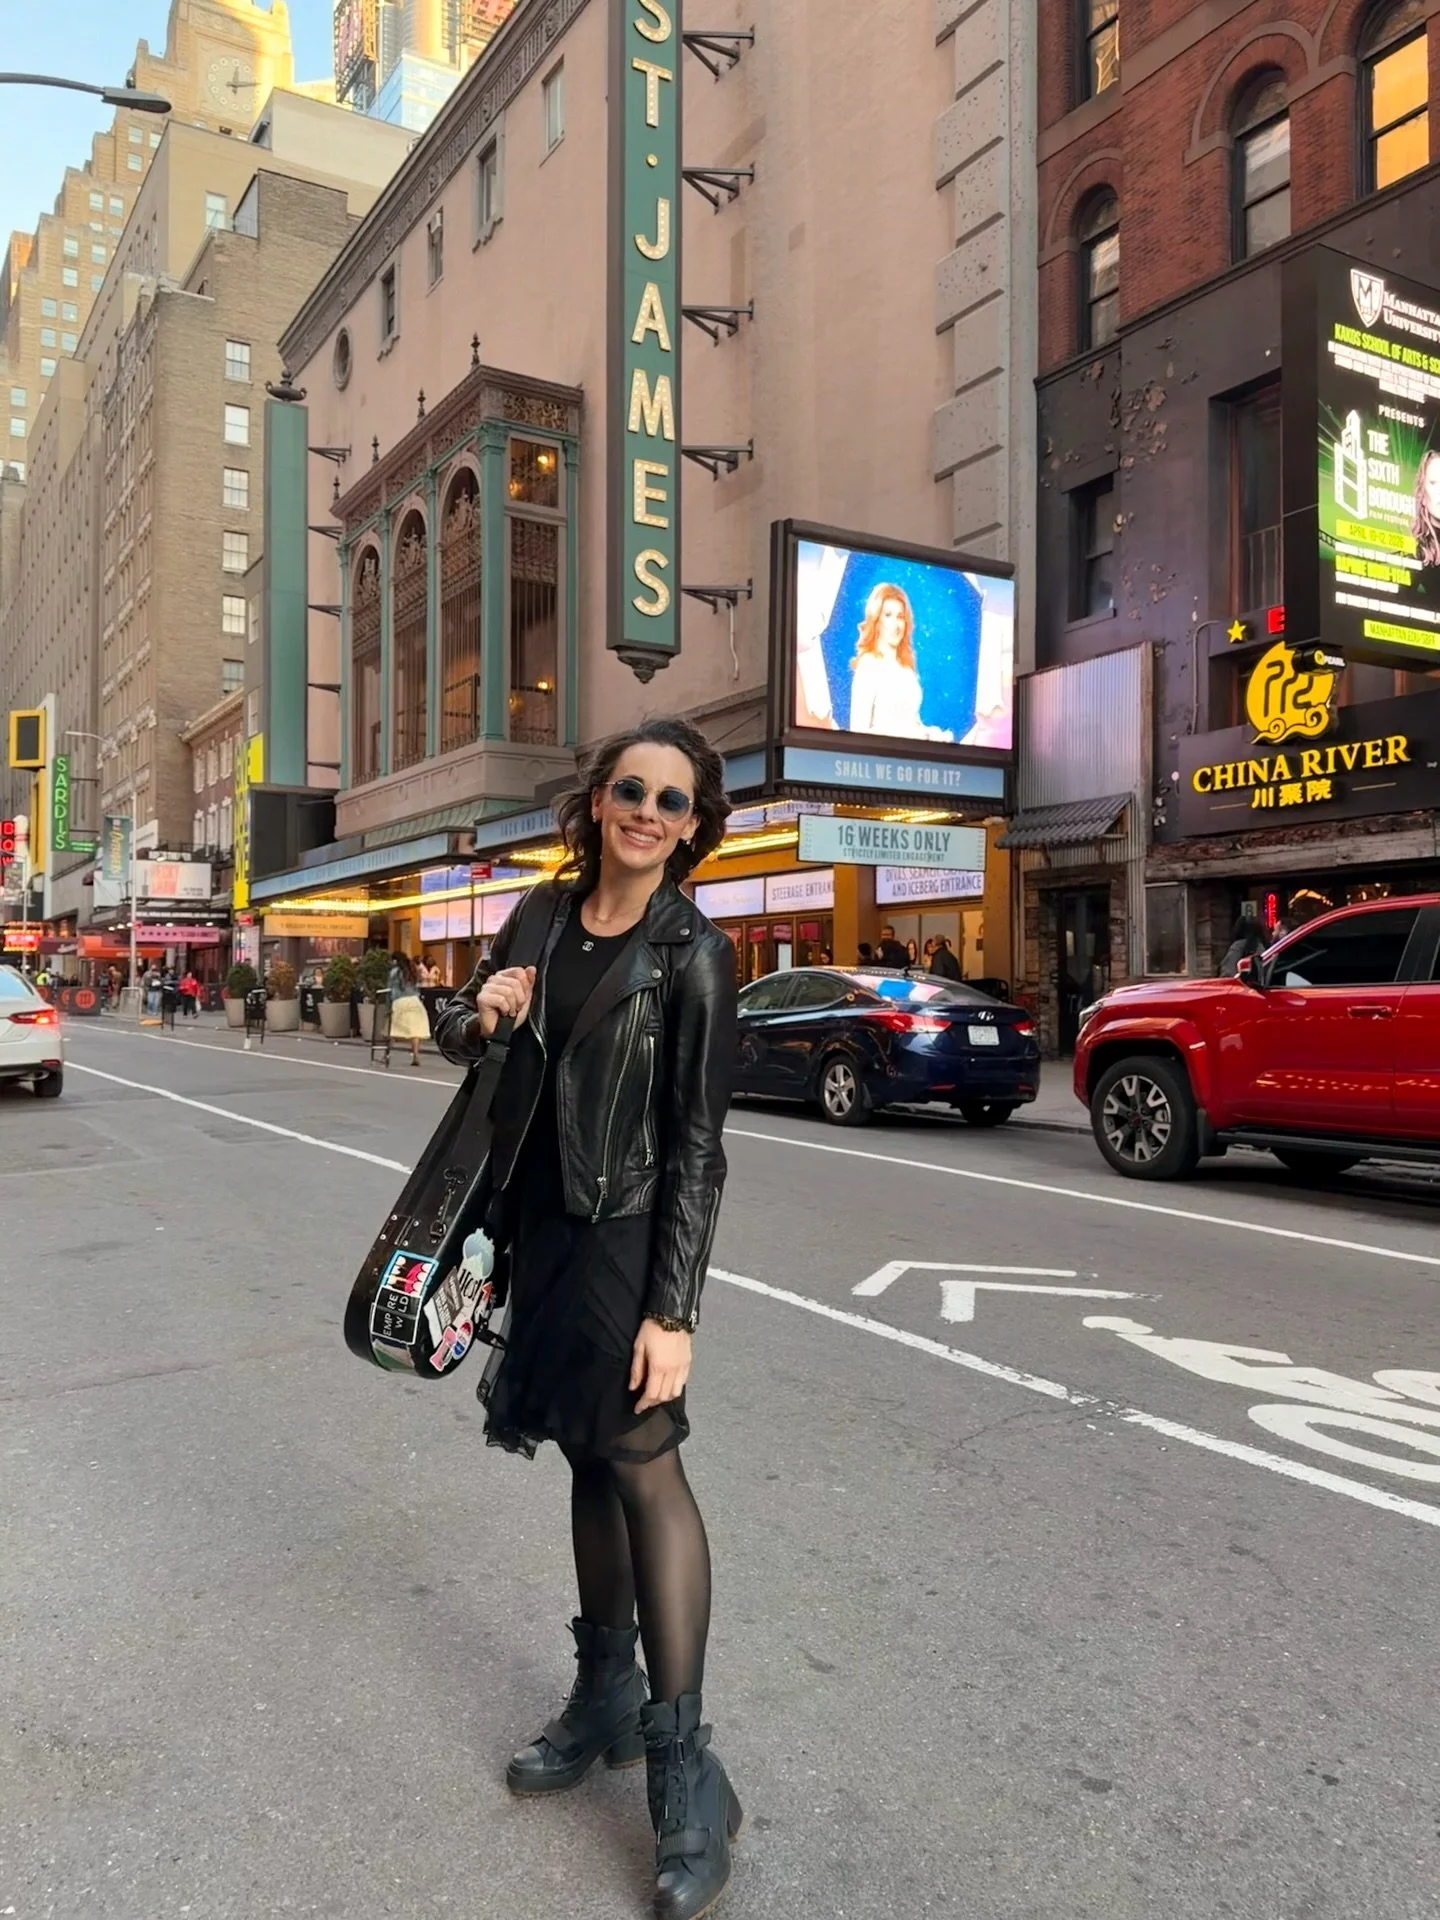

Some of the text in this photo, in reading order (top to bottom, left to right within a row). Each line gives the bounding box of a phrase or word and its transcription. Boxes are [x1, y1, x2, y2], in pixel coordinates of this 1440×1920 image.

[1361, 333, 1391, 357] SCHOOL
[1391, 343, 1402, 360] OF
[1402, 347, 1422, 367] ARTS
[628, 197, 675, 617] JAMES
[1378, 404, 1425, 428] PRESENTS
[1367, 429, 1389, 456] THE
[1367, 457, 1399, 487] SIXTH
[834, 759, 961, 787] SHALL WE GO FOR IT?
[1192, 735, 1411, 793] CHINA RIVER
[54, 756, 68, 849] SARDI'S
[837, 824, 855, 847] 16
[859, 825, 909, 851] WEEKS
[914, 831, 951, 854] ONLY
[874, 850, 902, 861] LIMITED
[902, 851, 945, 863] ENGAGEMENT
[771, 884, 803, 901] STEERAGE
[892, 875, 982, 897] AND ICEBERG ENTRANCE
